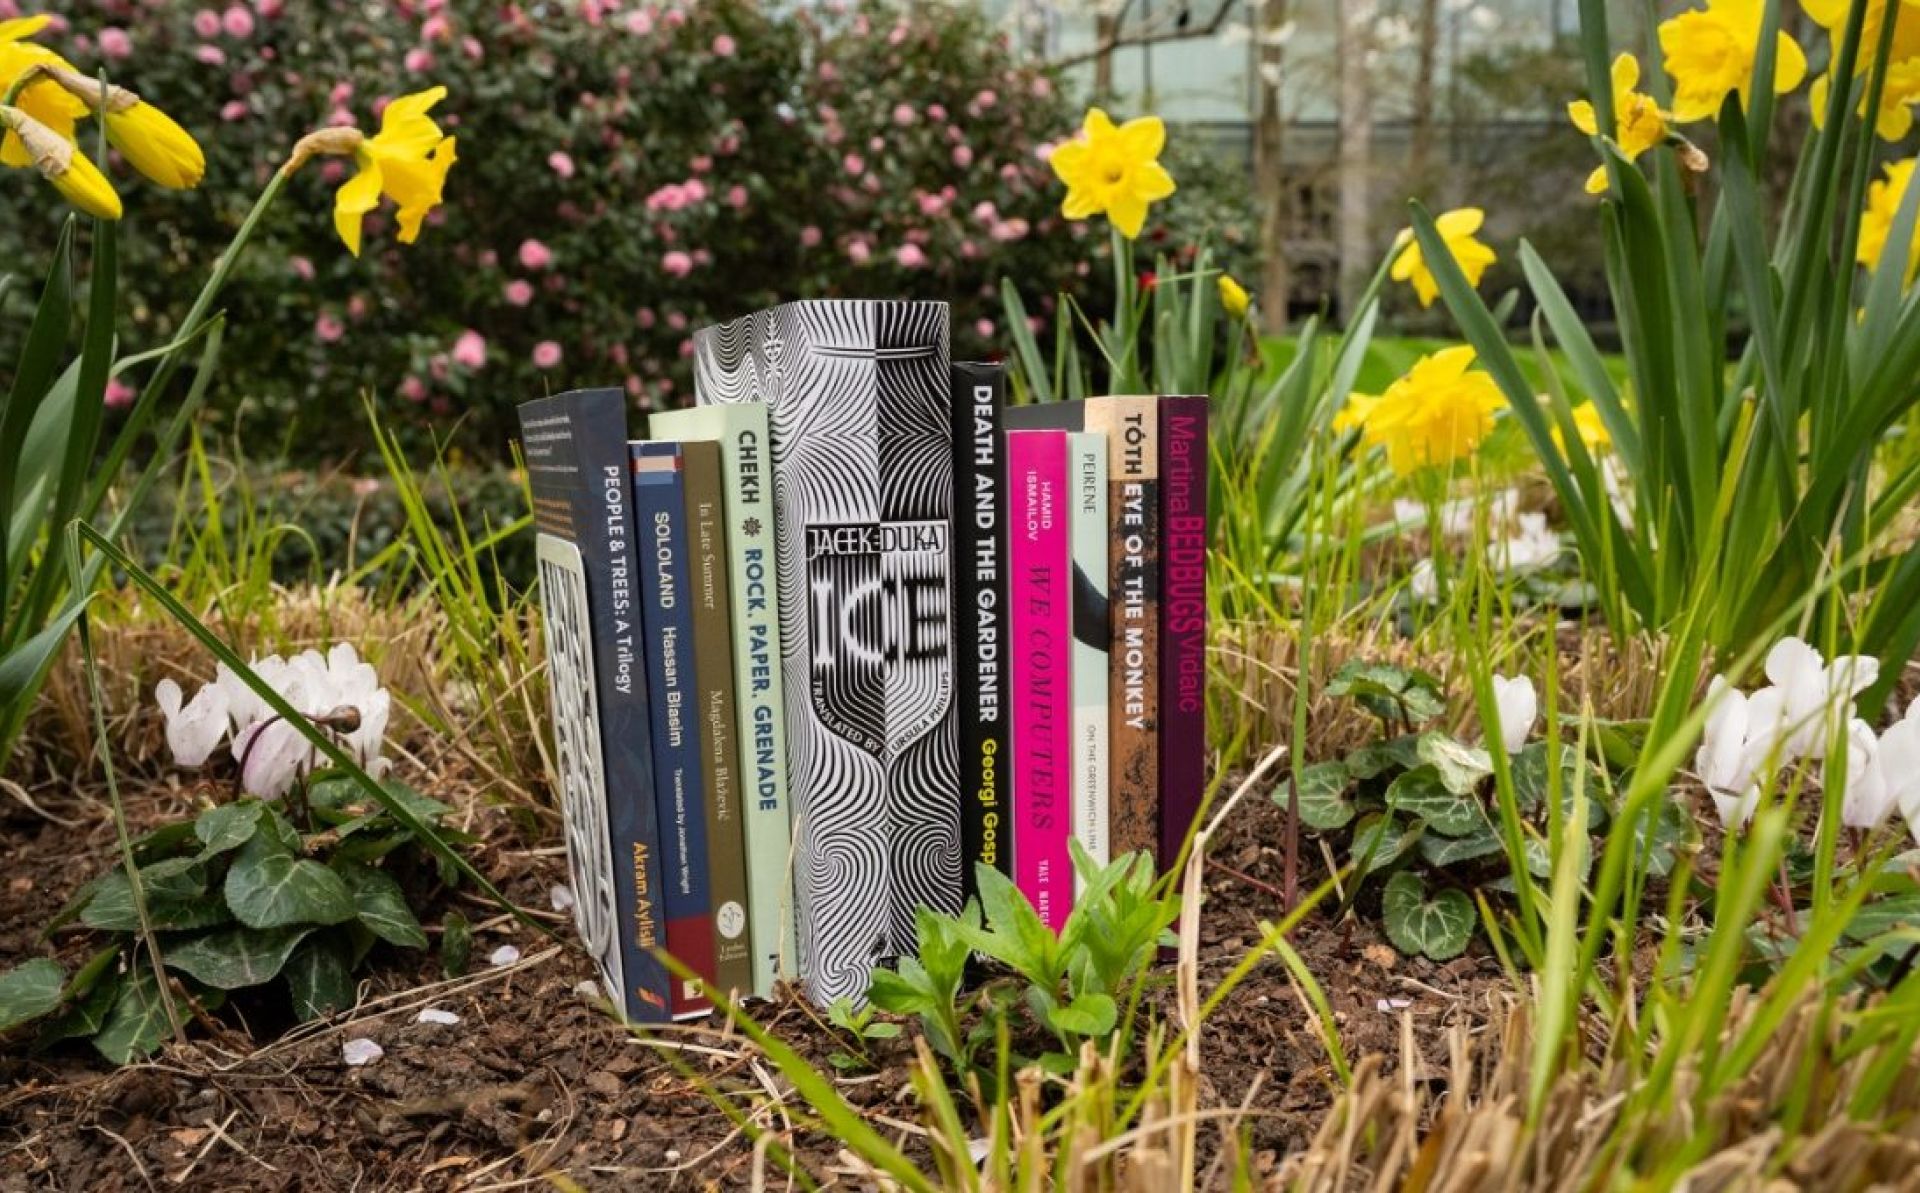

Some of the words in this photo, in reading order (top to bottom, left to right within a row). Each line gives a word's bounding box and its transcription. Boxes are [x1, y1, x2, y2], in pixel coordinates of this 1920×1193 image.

[973, 386, 994, 464] DEATH
[1125, 414, 1147, 475] TÓTH
[738, 429, 760, 504] CHEKH
[1083, 453, 1096, 514] PEIRENE
[1170, 416, 1195, 513] Martina
[603, 465, 625, 536] PEOPLE
[700, 502, 712, 521] In
[975, 473, 995, 529] AND
[1027, 471, 1038, 541] ISMAILOV
[1041, 481, 1052, 529] HAMID
[1125, 484, 1143, 526] EYE
[609, 540, 626, 552] &
[654, 511, 675, 610] SOLOLAND
[701, 524, 714, 551] Late
[806, 526, 880, 560] JACEK
[976, 537, 996, 581] THE
[1125, 534, 1143, 567] OF
[610, 556, 630, 617] TREES:
[702, 553, 716, 610] Summer
[1030, 566, 1051, 617] WE
[1125, 576, 1143, 619] THE
[1168, 517, 1205, 633] BEDBUGS
[615, 620, 632, 633] A
[812, 577, 947, 666] ICE
[614, 637, 635, 695] Trilogy
[662, 626, 677, 687] Hassan
[977, 589, 998, 722] GARDENER
[1125, 628, 1144, 729] MONKEY
[667, 691, 684, 747] Blasim
[708, 689, 727, 764] Magdalena
[812, 681, 864, 743] TRANSLATED
[864, 733, 881, 751] BY
[891, 718, 929, 752] URSULA
[926, 670, 950, 727] PHILLIPS
[1030, 631, 1055, 831] COMPUTERS
[1087, 724, 1097, 741] ON
[754, 704, 778, 811] GRENADE
[978, 738, 997, 807] Georgi
[1087, 744, 1097, 762] THE
[673, 767, 685, 812] Translated
[1087, 764, 1097, 827] GREENWICH
[675, 813, 685, 824] by
[677, 826, 688, 865] Jonathan
[1088, 829, 1097, 851] LINE
[633, 841, 649, 896] Akram
[680, 866, 691, 895] Wright
